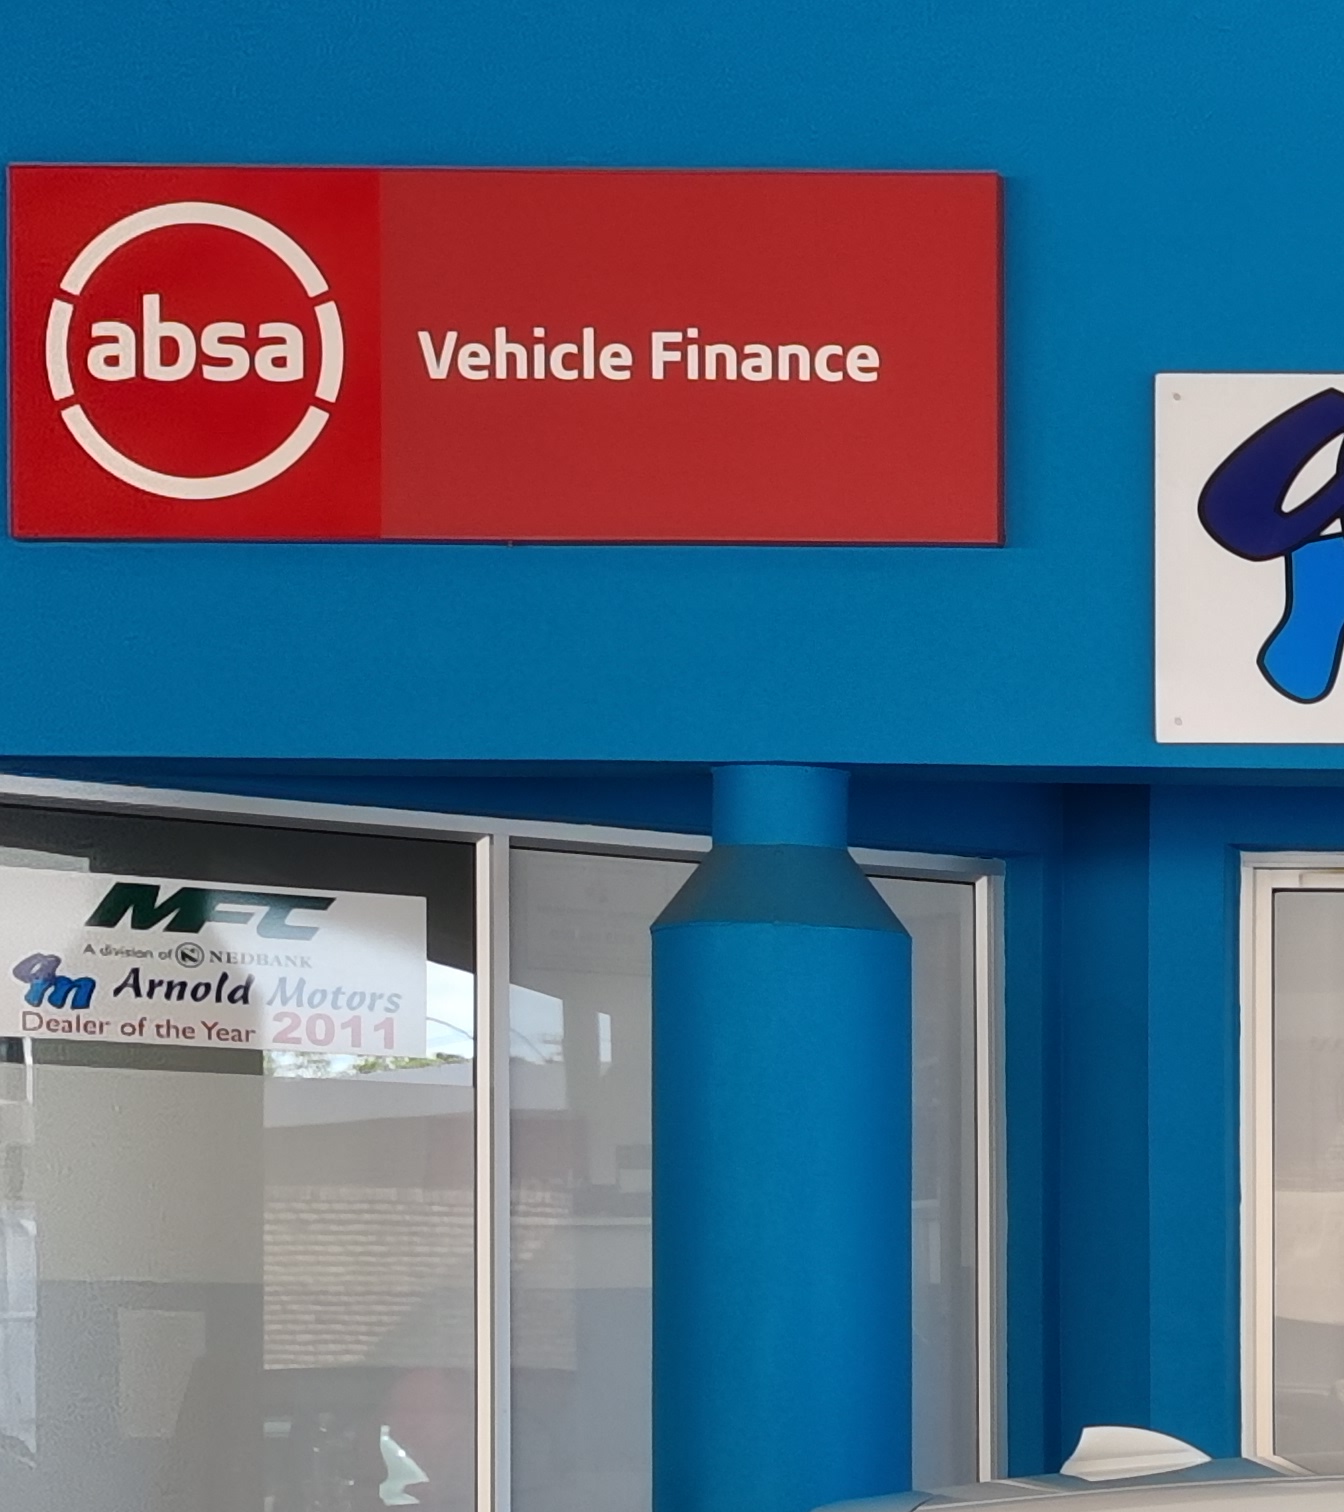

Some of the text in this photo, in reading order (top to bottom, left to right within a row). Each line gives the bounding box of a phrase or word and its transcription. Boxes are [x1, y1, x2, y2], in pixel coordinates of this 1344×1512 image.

[87, 294, 304, 382] absa
[418, 327, 880, 383] Vehicle Finance
[85, 882, 336, 941] MFC
[82, 943, 96, 956] A
[209, 950, 314, 970] NEDBANK
[113, 967, 403, 1014] Arnold Motors
[22, 1011, 395, 1050] Dealer of the Year 2011
